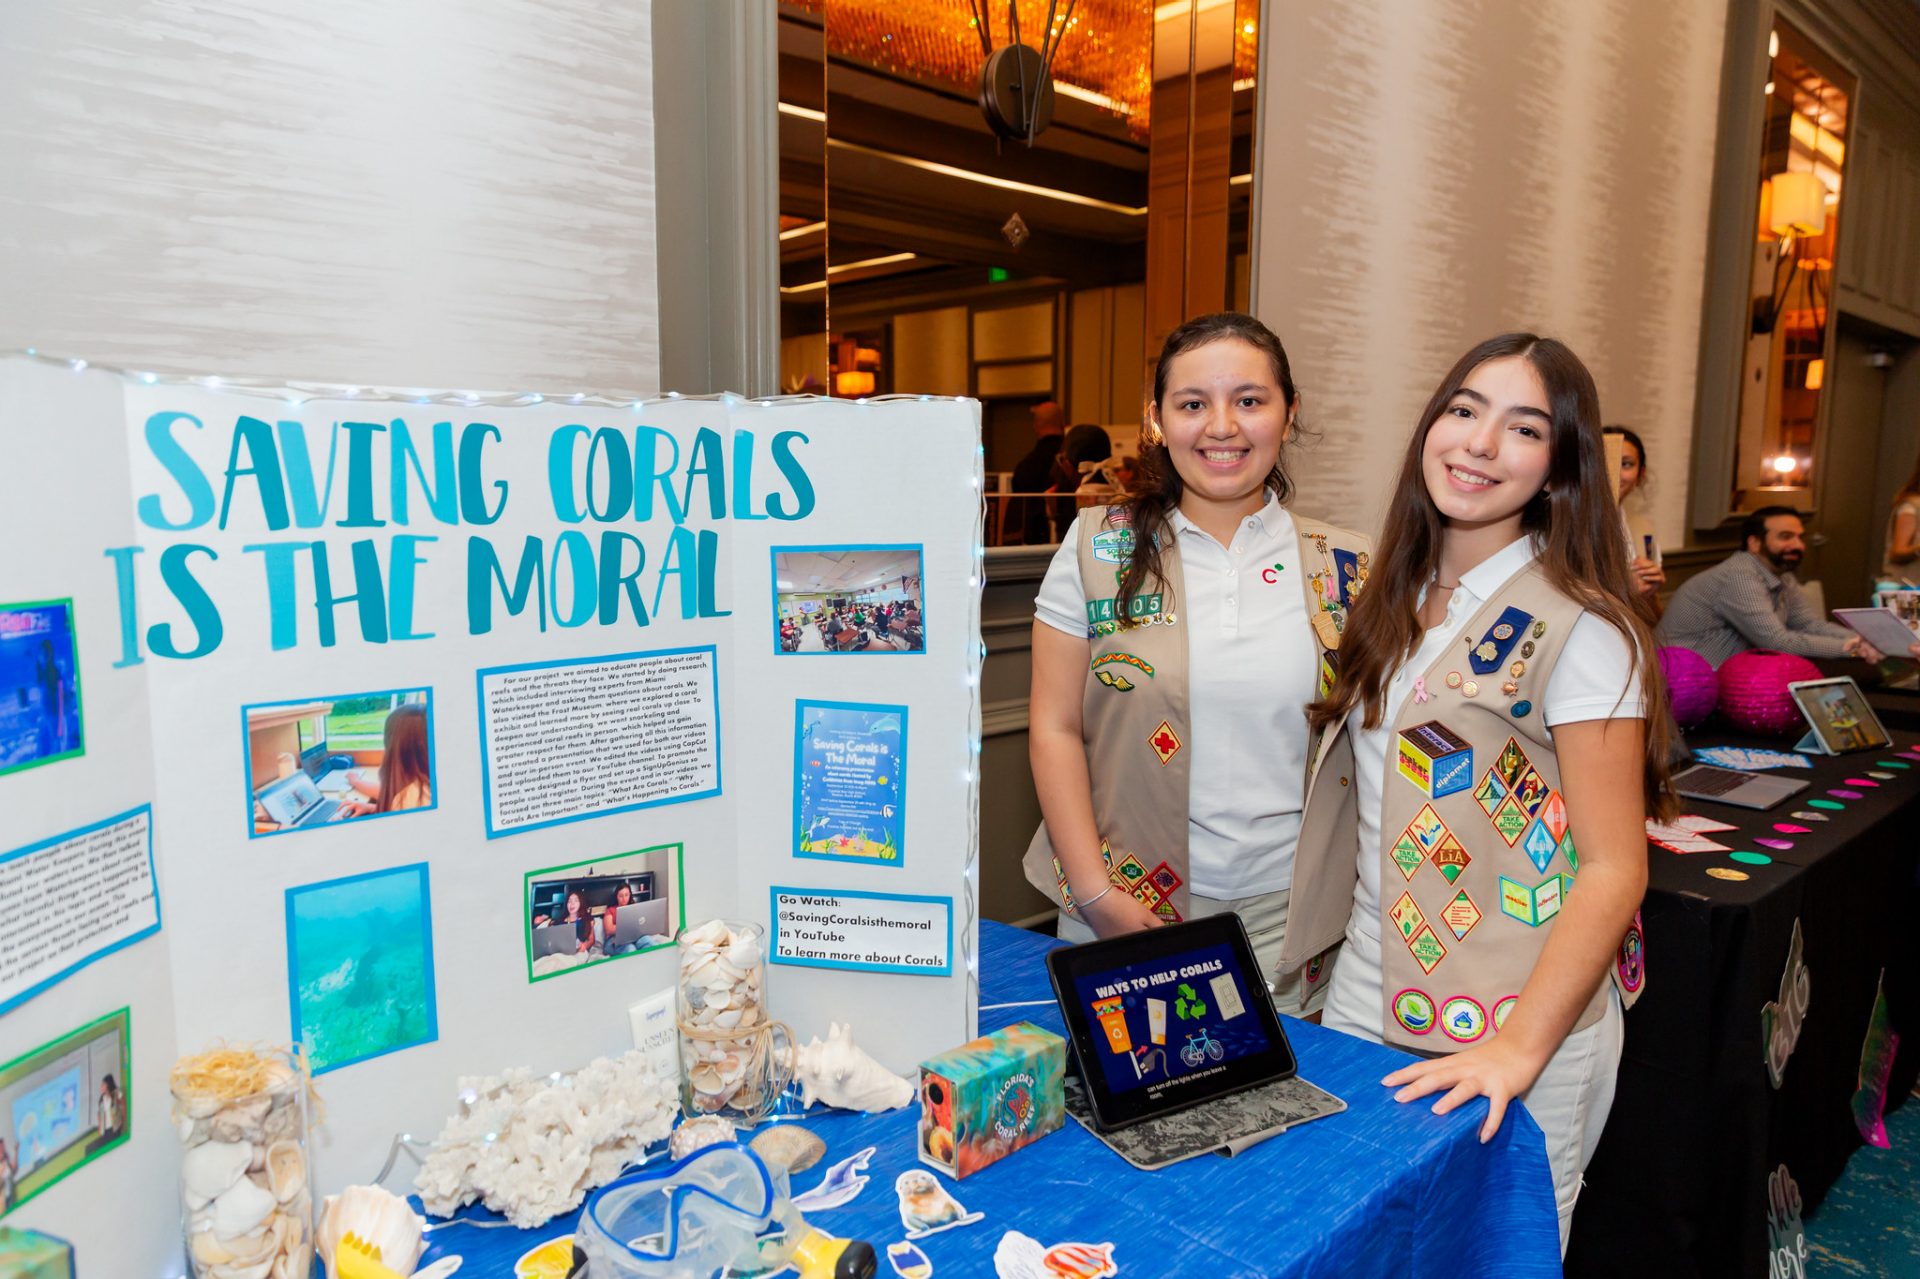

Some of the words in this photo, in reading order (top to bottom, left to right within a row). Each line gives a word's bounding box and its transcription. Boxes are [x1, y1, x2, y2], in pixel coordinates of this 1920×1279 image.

[138, 411, 508, 531] SAVING
[548, 423, 816, 527] CORALS
[104, 543, 223, 669] IS
[243, 535, 438, 650] THE
[468, 525, 732, 635] MORAL
[490, 686, 510, 695] reefs
[543, 680, 569, 688] threats
[621, 668, 645, 678] started
[678, 661, 707, 670] research
[575, 665, 599, 675] aimed
[609, 662, 637, 671] educate
[638, 658, 662, 668] people
[663, 656, 684, 664] about
[685, 653, 702, 661] coral
[491, 695, 514, 704] which
[516, 690, 548, 700] included
[549, 685, 596, 696] interviewing
[597, 681, 624, 690] experts
[510, 711, 536, 721] visited
[551, 706, 569, 714] Frost
[641, 691, 673, 701] explored
[680, 687, 697, 696] coral
[561, 695, 585, 704] asking
[607, 688, 640, 699] questions
[641, 684, 662, 693] about
[493, 723, 520, 733] exhibit
[539, 715, 567, 726] learned
[601, 708, 624, 716] seeing
[625, 704, 640, 712] real
[641, 701, 662, 710] corals
[494, 733, 523, 742] deepen
[609, 716, 627, 724] went
[629, 710, 665, 721] snorkeling
[495, 737, 542, 751] experienced
[544, 734, 563, 743] coral
[564, 731, 583, 740] reefs
[620, 722, 641, 731] which
[642, 718, 666, 728] helped
[676, 715, 691, 724] gain
[495, 751, 524, 762] greater
[526, 745, 553, 755] respect
[589, 737, 607, 745] After
[609, 731, 643, 744] gathering
[813, 738, 845, 754] Saving
[846, 740, 879, 754] Corals
[510, 756, 539, 767] created
[547, 748, 594, 762] presentation
[595, 745, 610, 753] that
[624, 739, 641, 748] used
[653, 735, 669, 743] both
[683, 730, 705, 738] videos
[602, 750, 625, 760] edited
[639, 746, 661, 754] videos
[663, 742, 681, 750] using
[682, 738, 706, 747] CapCut
[826, 752, 844, 763] The
[845, 753, 876, 766] Moral
[514, 772, 550, 786] uploaded
[552, 770, 571, 778] them
[596, 760, 626, 770] YouTube
[666, 748, 695, 759] promote
[1436, 758, 1470, 788] diplomat
[498, 796, 525, 808] people
[527, 791, 547, 801] could
[580, 782, 605, 791] During
[619, 775, 639, 784] event
[537, 777, 570, 790] designed
[579, 775, 596, 783] flyer
[499, 804, 529, 815] focused
[542, 799, 561, 807] three
[563, 795, 581, 803] main
[500, 815, 524, 825] Corals
[631, 787, 669, 799] Happening
[1440, 851, 1464, 863] LiA
[779, 895, 797, 905] Go
[800, 895, 841, 907] Watch:
[779, 911, 931, 930] @SavingCoralsisthemoral
[780, 928, 790, 938] in
[794, 929, 845, 943] YouTube
[779, 945, 792, 956] To
[796, 947, 826, 958] learn
[830, 953, 861, 962] more
[865, 952, 901, 964] about
[904, 953, 943, 966] Corals
[1096, 982, 1130, 998] WAYS
[1131, 977, 1148, 990] TO
[1149, 970, 1178, 986] HELP
[1179, 959, 1223, 978] CORALS
[997, 1074, 1034, 1100] FLORIDA'S
[995, 1121, 1017, 1138] CORAL
[1019, 1105, 1035, 1131] REEF
